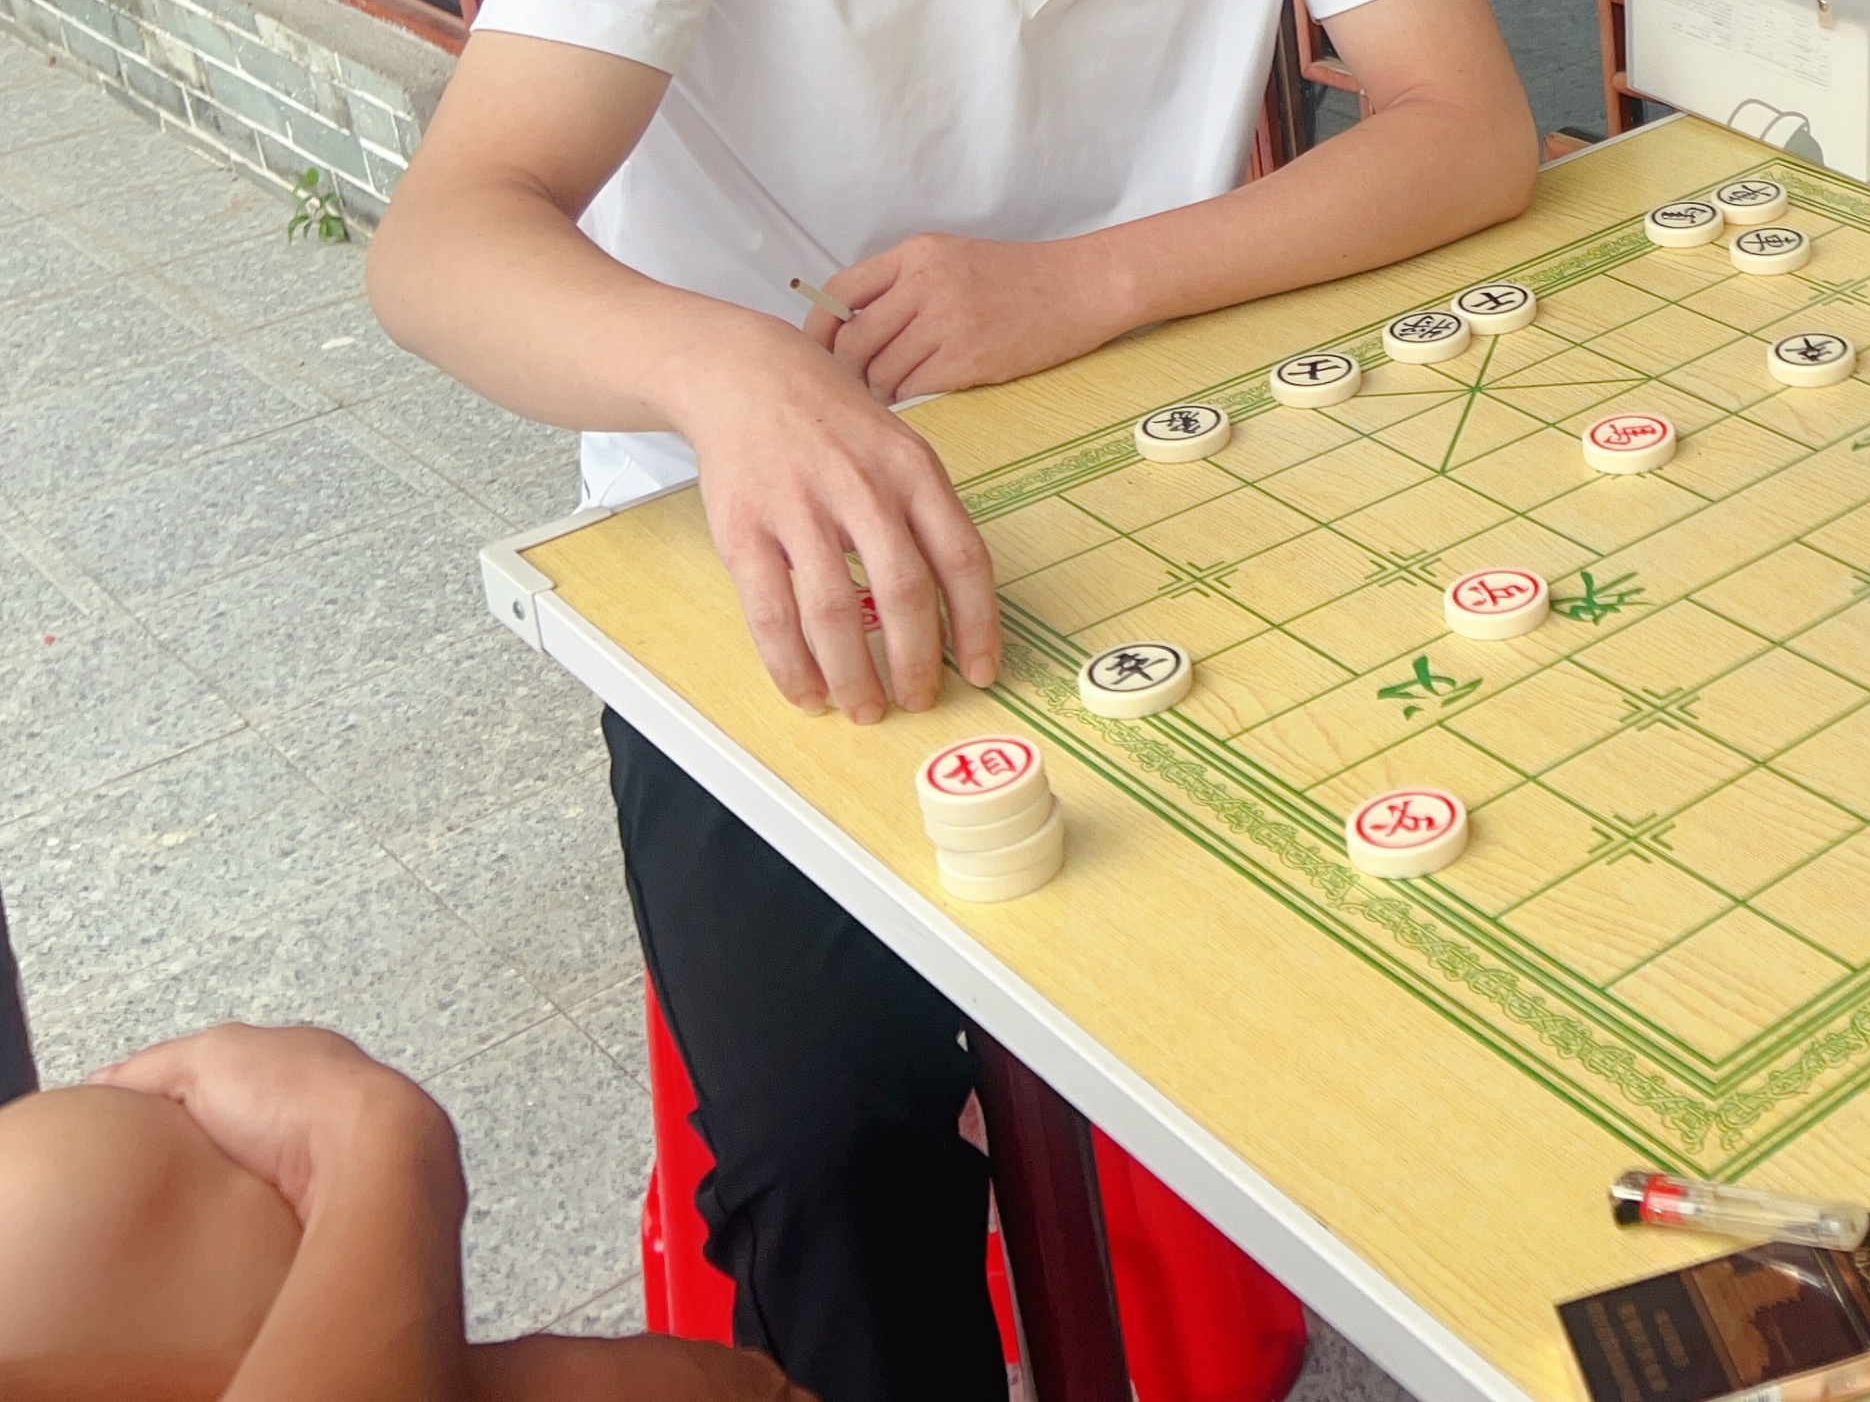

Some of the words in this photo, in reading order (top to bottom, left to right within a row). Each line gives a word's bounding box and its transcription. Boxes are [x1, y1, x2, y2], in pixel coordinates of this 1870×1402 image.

[1469, 290, 1517, 312] 士
[1285, 357, 1344, 382] 士
[1466, 578, 1531, 608] 兵
[1103, 651, 1170, 687] 卒
[941, 746, 1019, 789] 相
[1368, 798, 1444, 839] 兵
